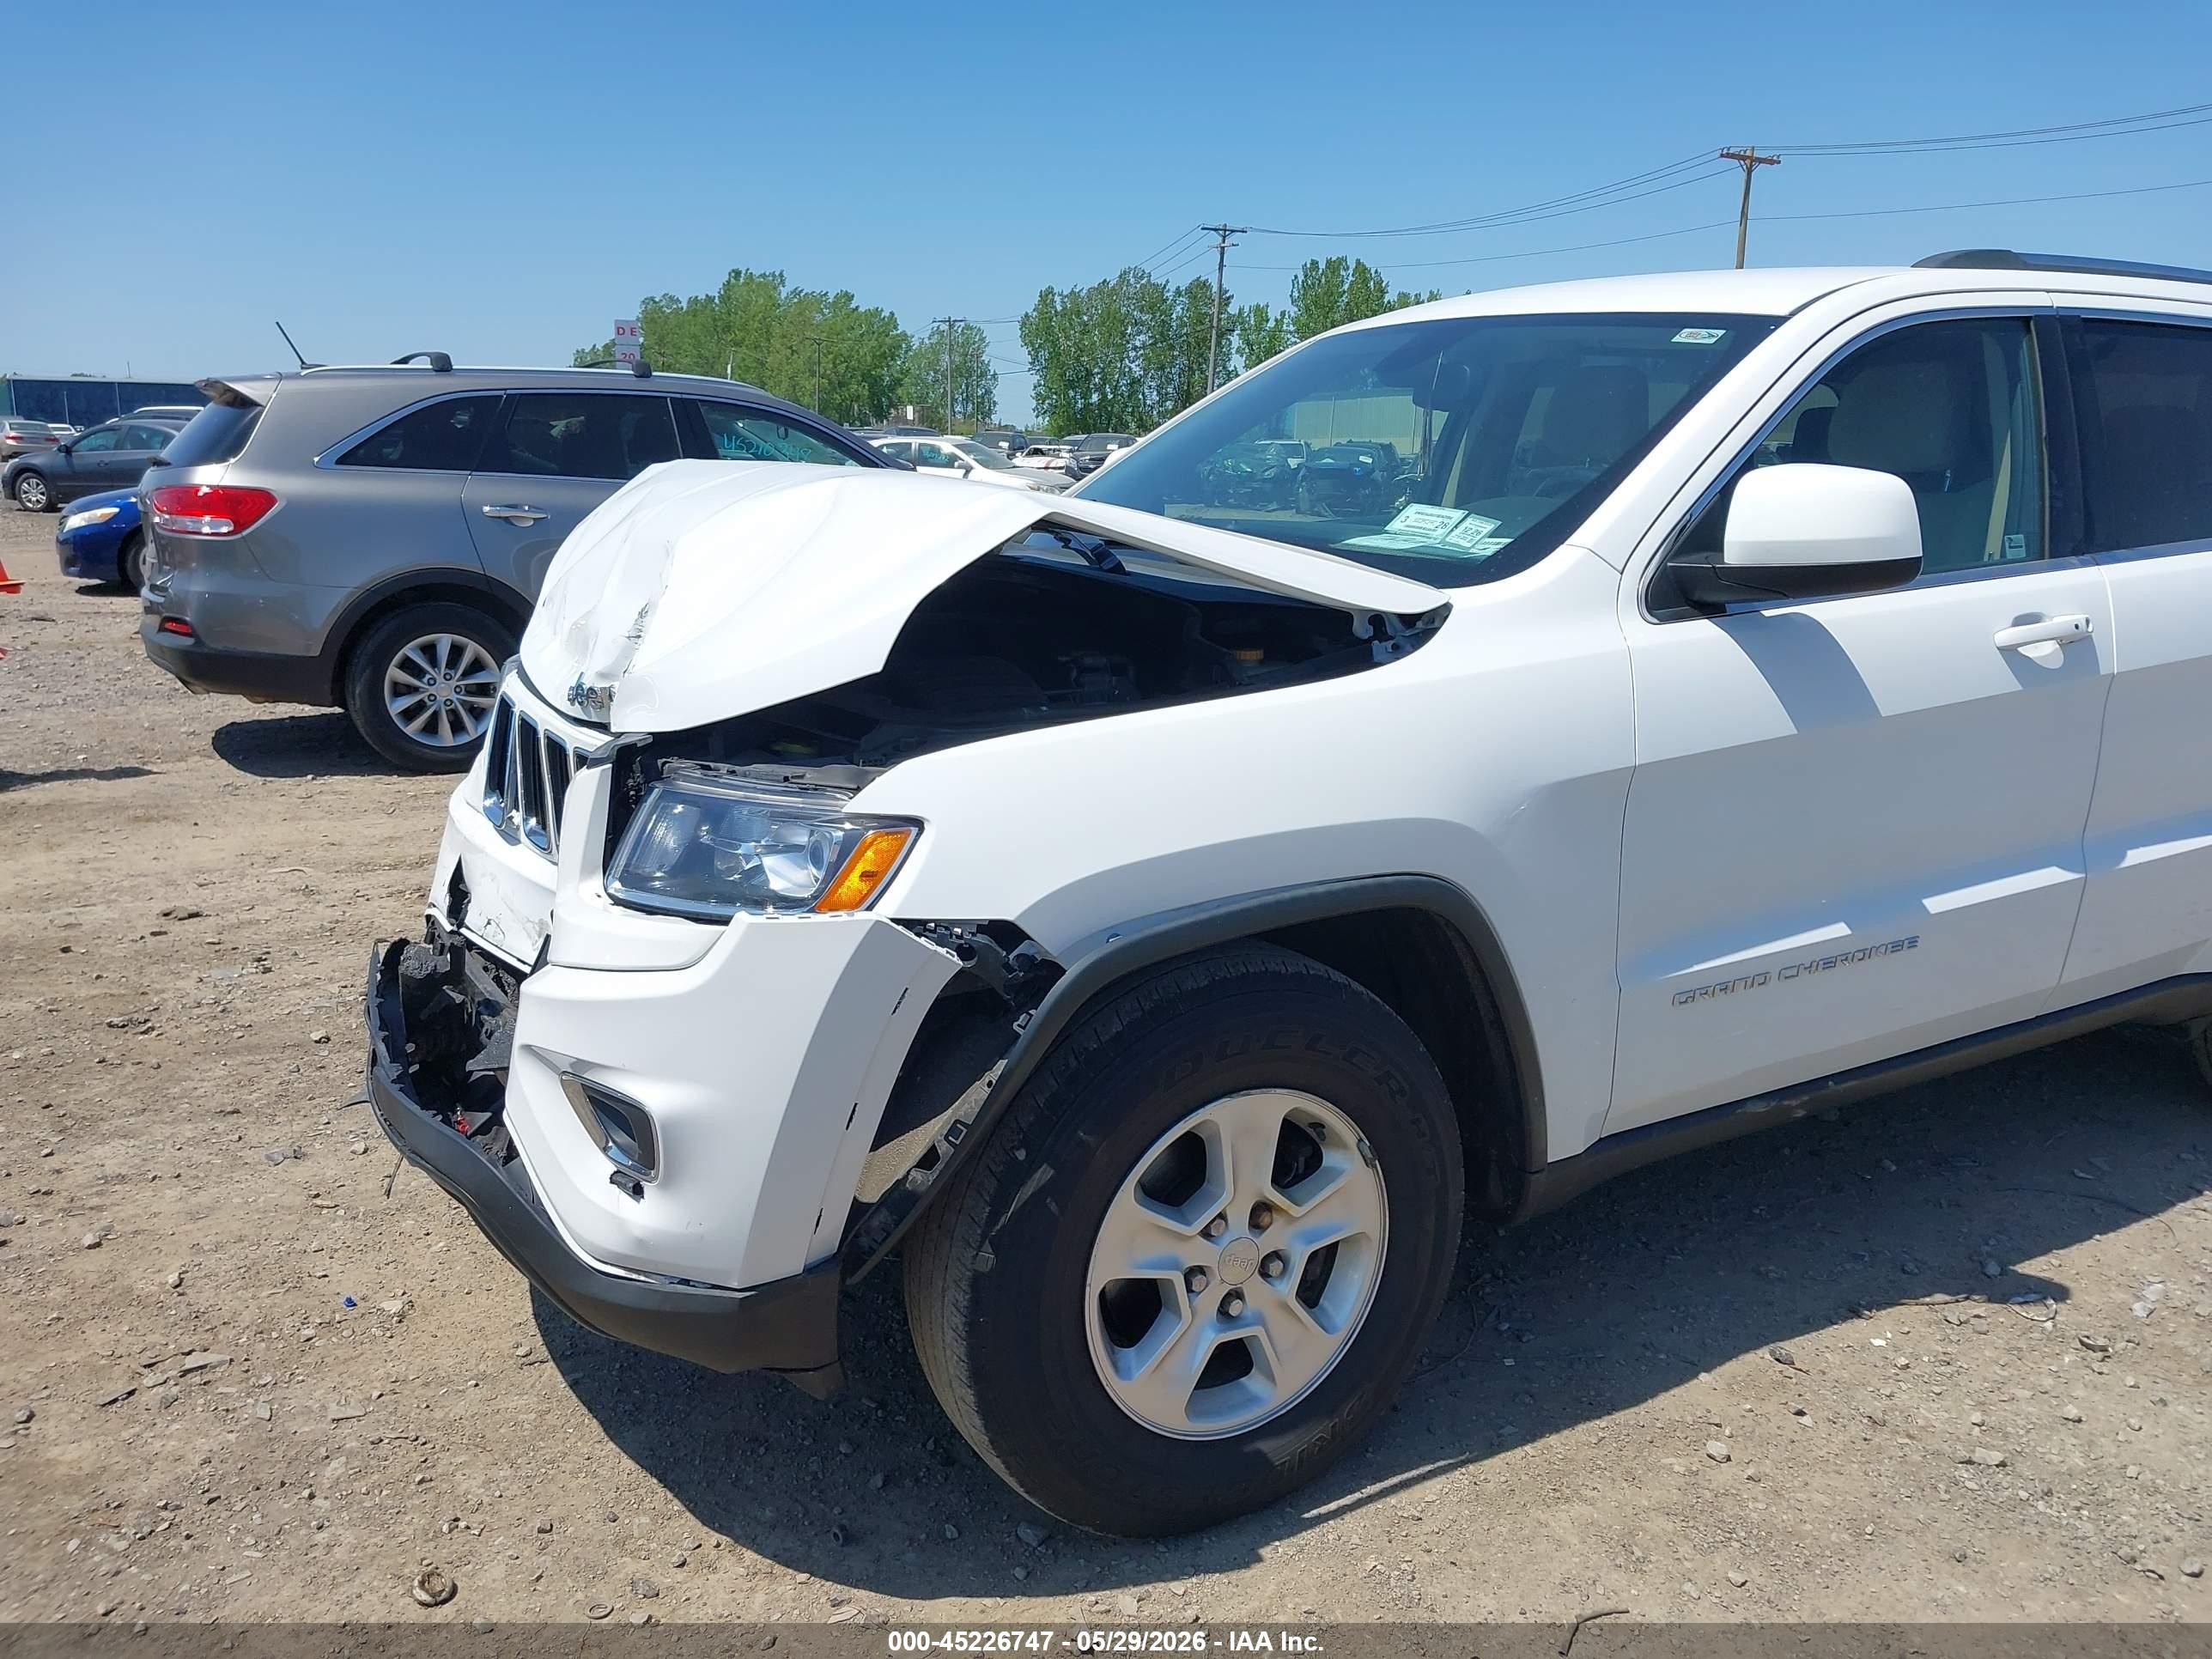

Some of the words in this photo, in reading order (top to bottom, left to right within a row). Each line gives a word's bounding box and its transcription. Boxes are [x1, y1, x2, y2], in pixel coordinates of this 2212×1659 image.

[1434, 520, 1450, 530] 28
[1671, 970, 1772, 1006] GRAND
[1778, 935, 1920, 982] CHEROKEE
[1224, 1254, 1255, 1271] Jeep
